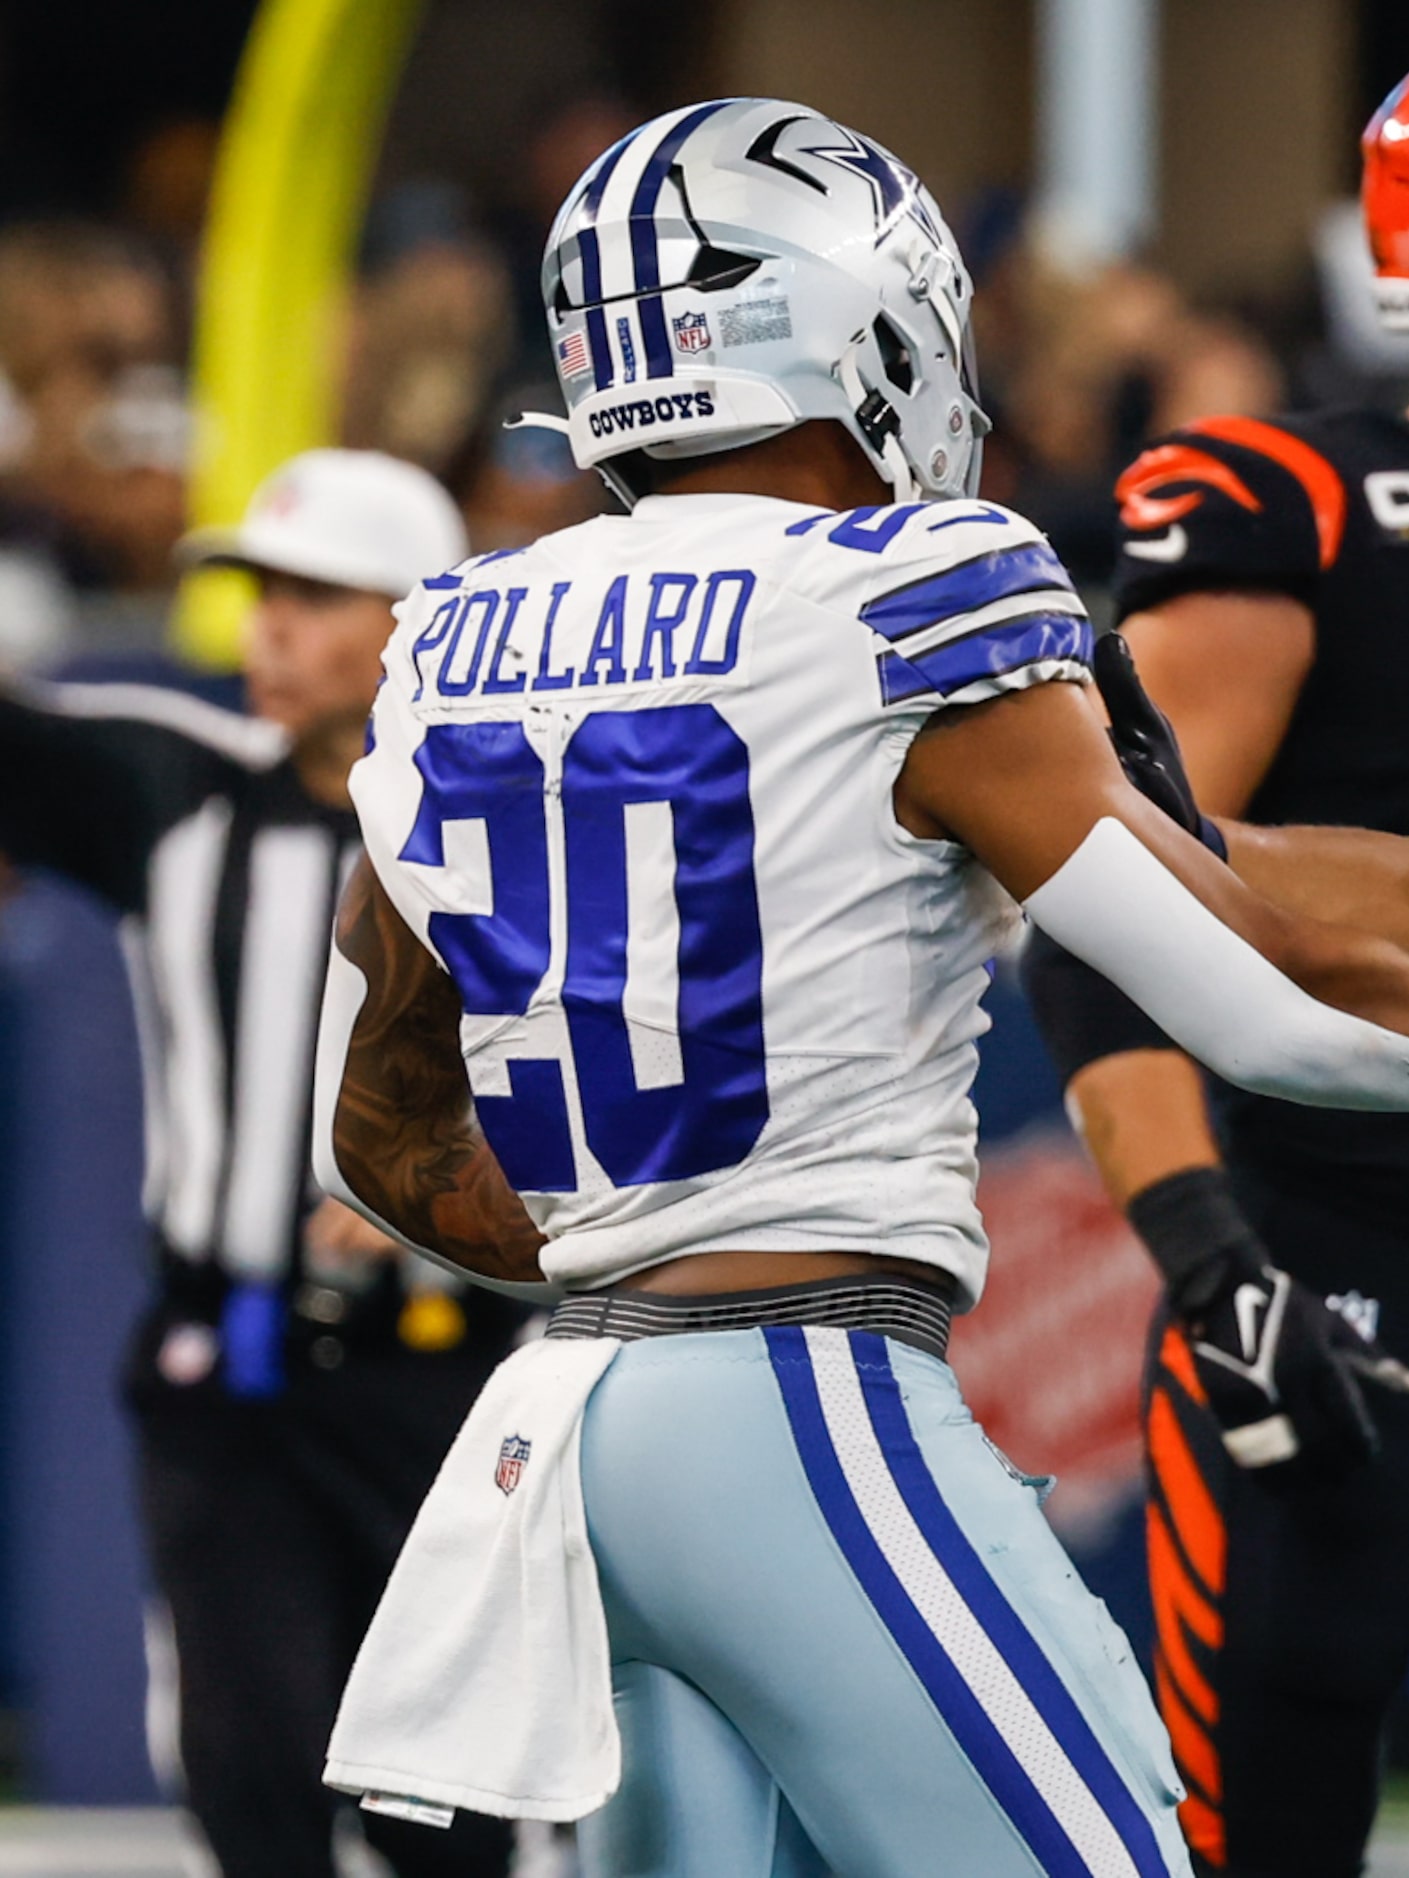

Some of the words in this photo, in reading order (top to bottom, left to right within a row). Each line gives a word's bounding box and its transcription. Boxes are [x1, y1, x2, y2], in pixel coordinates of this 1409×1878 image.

[589, 391, 715, 438] COWBOYS
[411, 569, 756, 703] POLLARD
[396, 703, 770, 1193] 20
